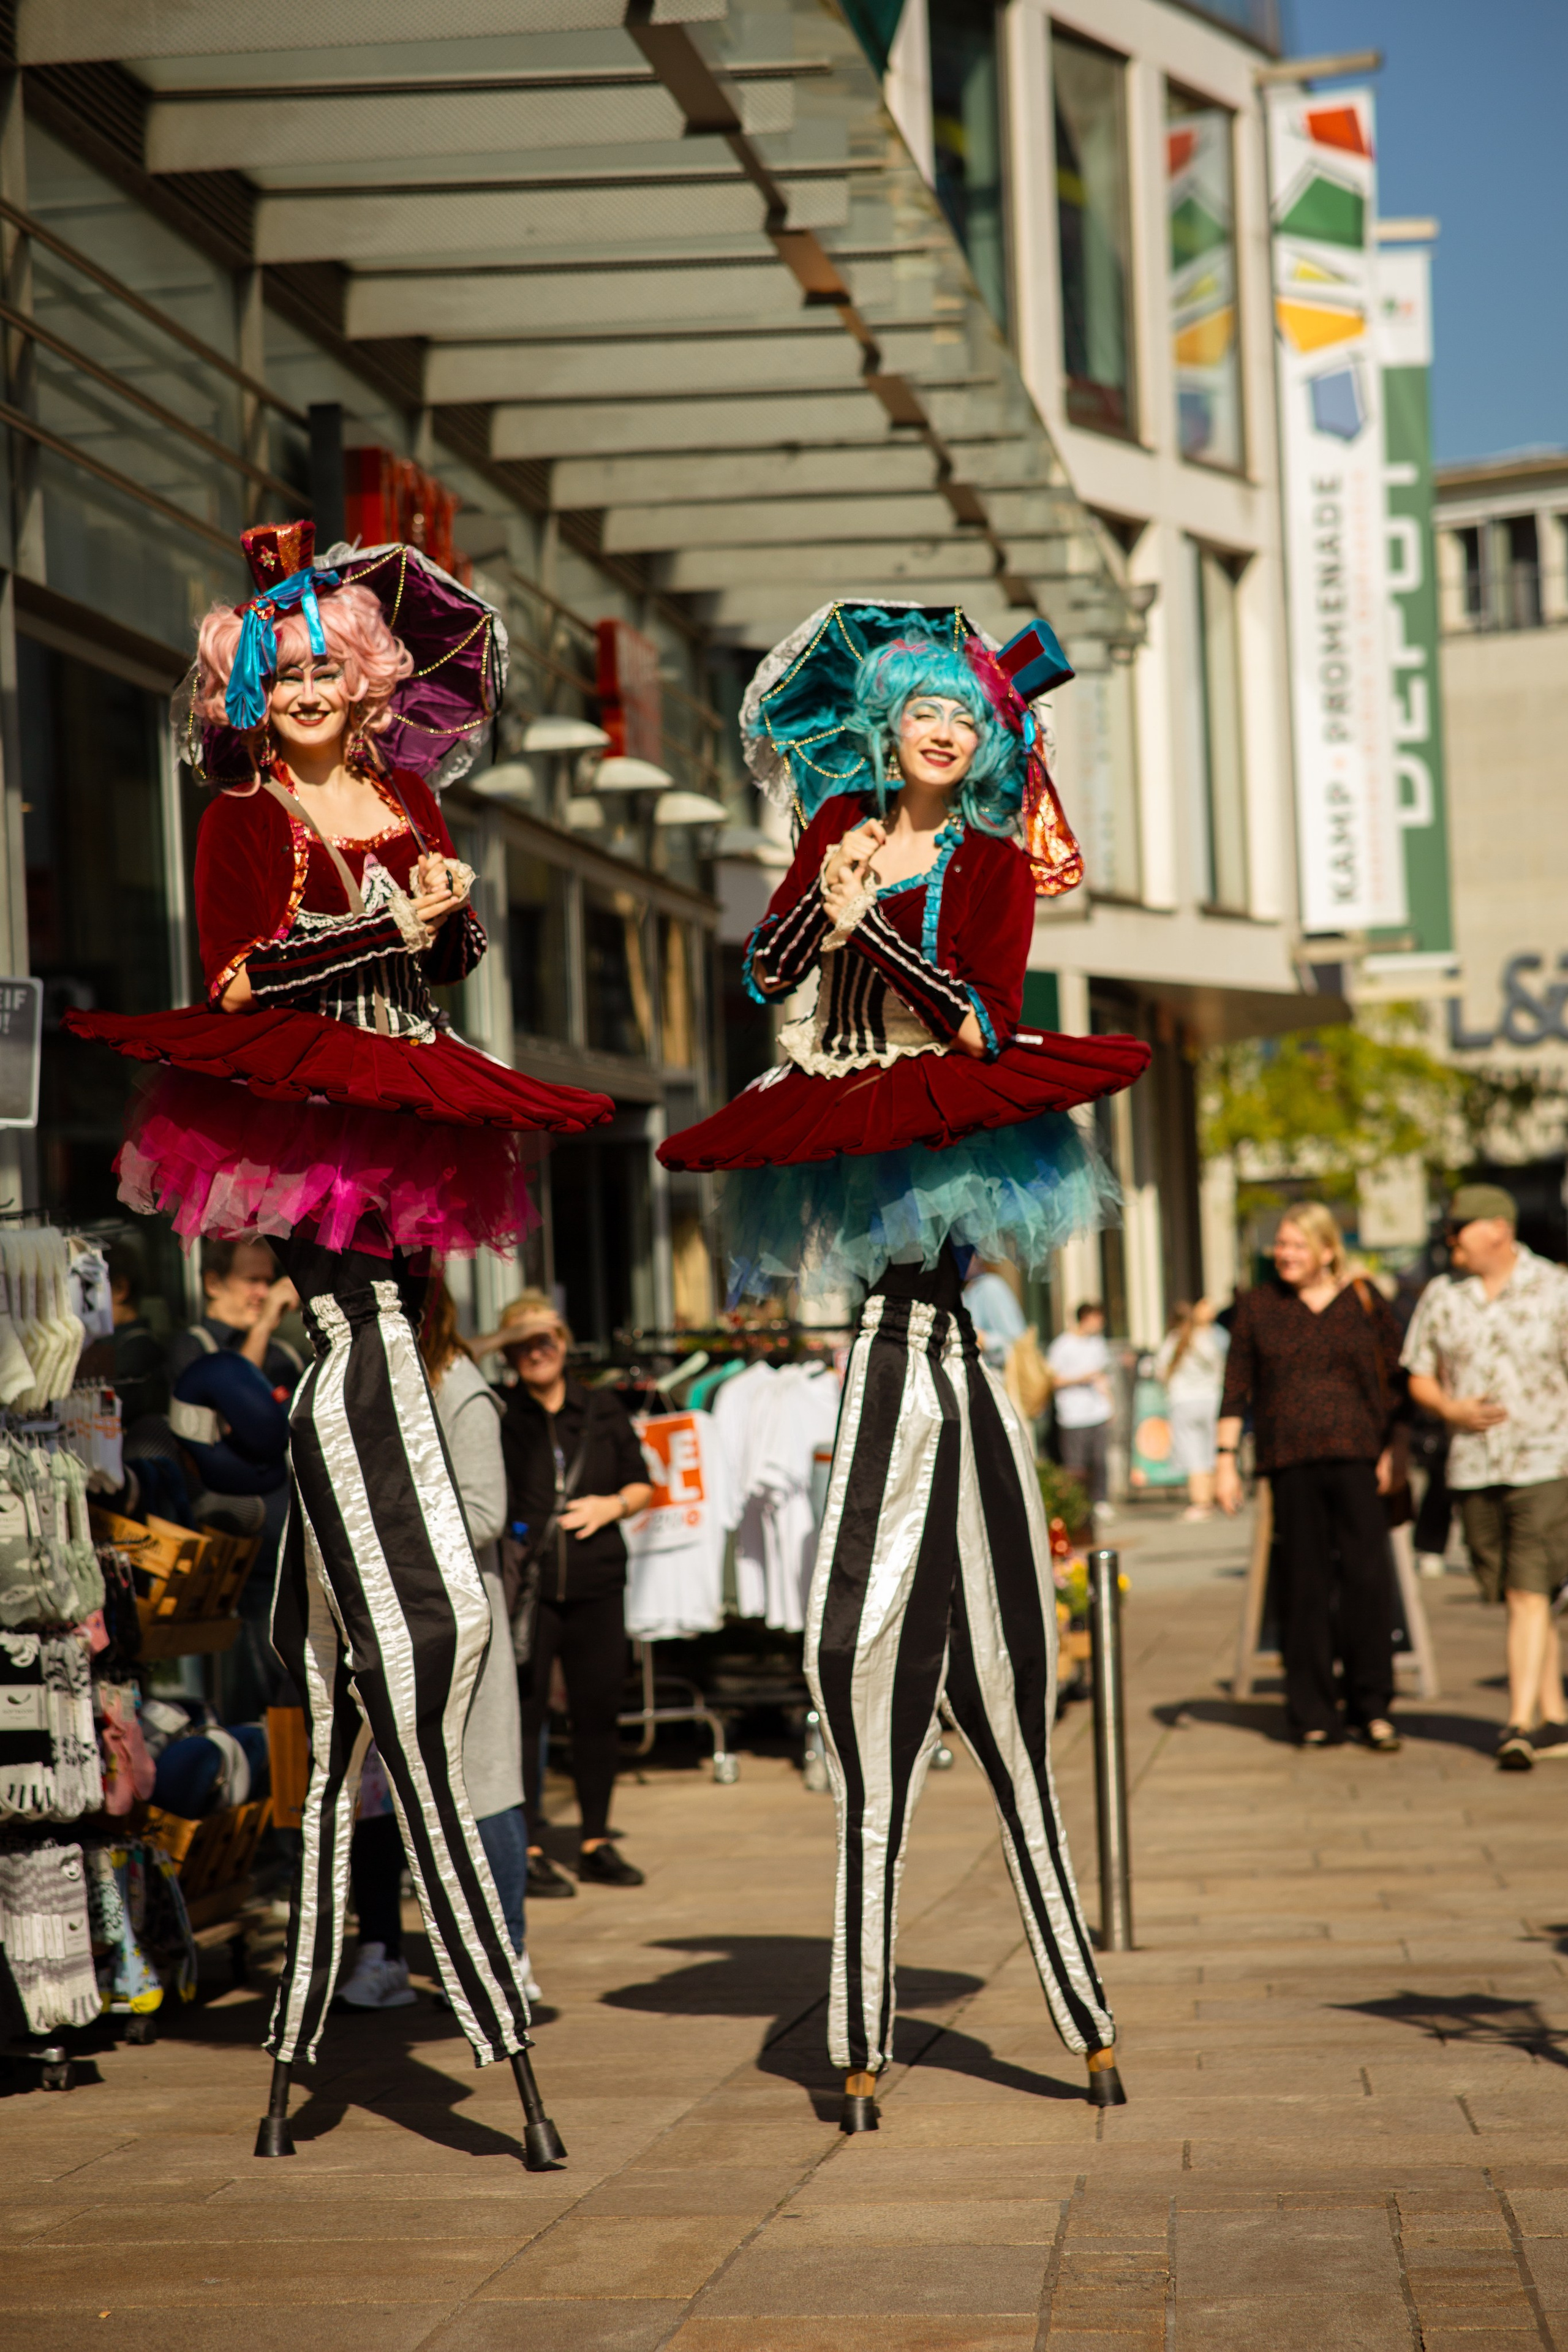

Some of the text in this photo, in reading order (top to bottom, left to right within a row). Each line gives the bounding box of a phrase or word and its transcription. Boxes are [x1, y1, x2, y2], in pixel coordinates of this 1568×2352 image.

[1309, 472, 1357, 906] KAMP PROMENADE
[0, 988, 27, 1011] IF
[1444, 952, 1568, 1050] L&
